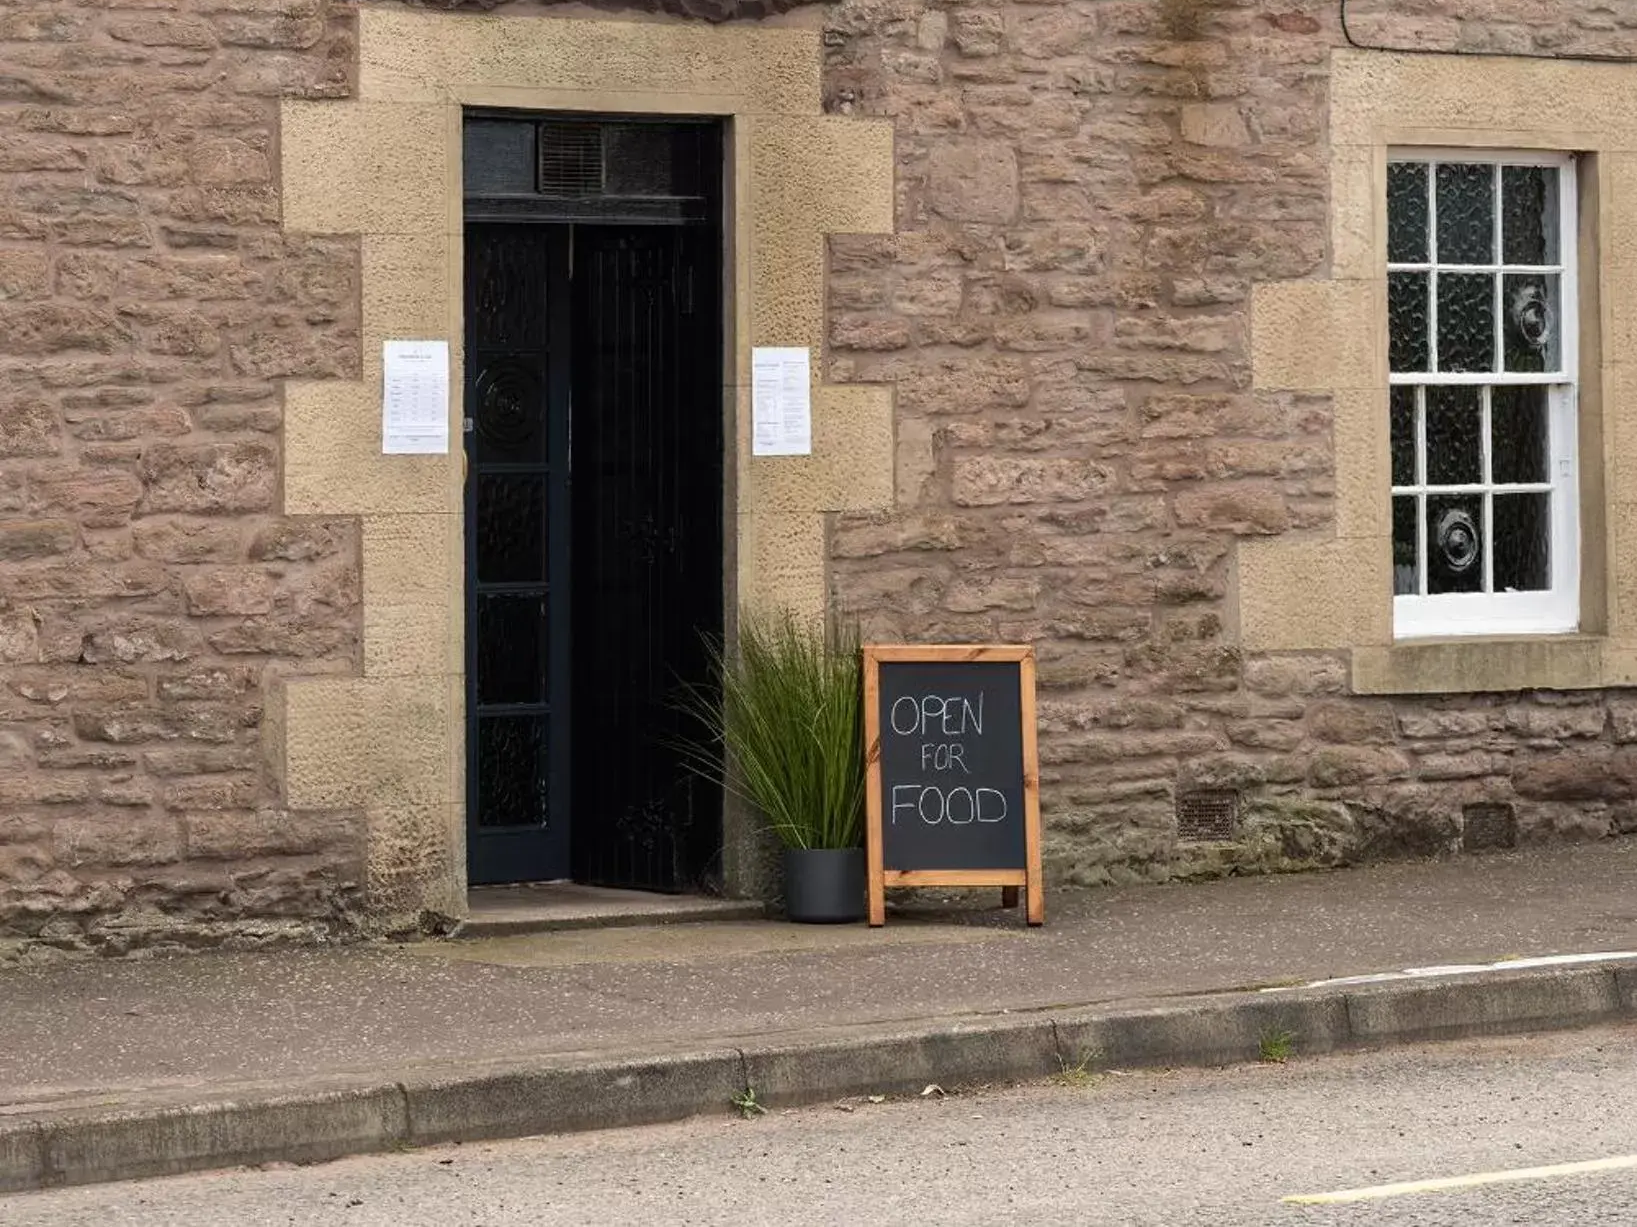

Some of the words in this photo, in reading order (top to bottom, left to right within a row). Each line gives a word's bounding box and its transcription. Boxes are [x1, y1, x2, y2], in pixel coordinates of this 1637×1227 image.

[891, 690, 984, 735] OPEN
[921, 743, 972, 774] FOR
[892, 785, 1007, 824] FOOD
